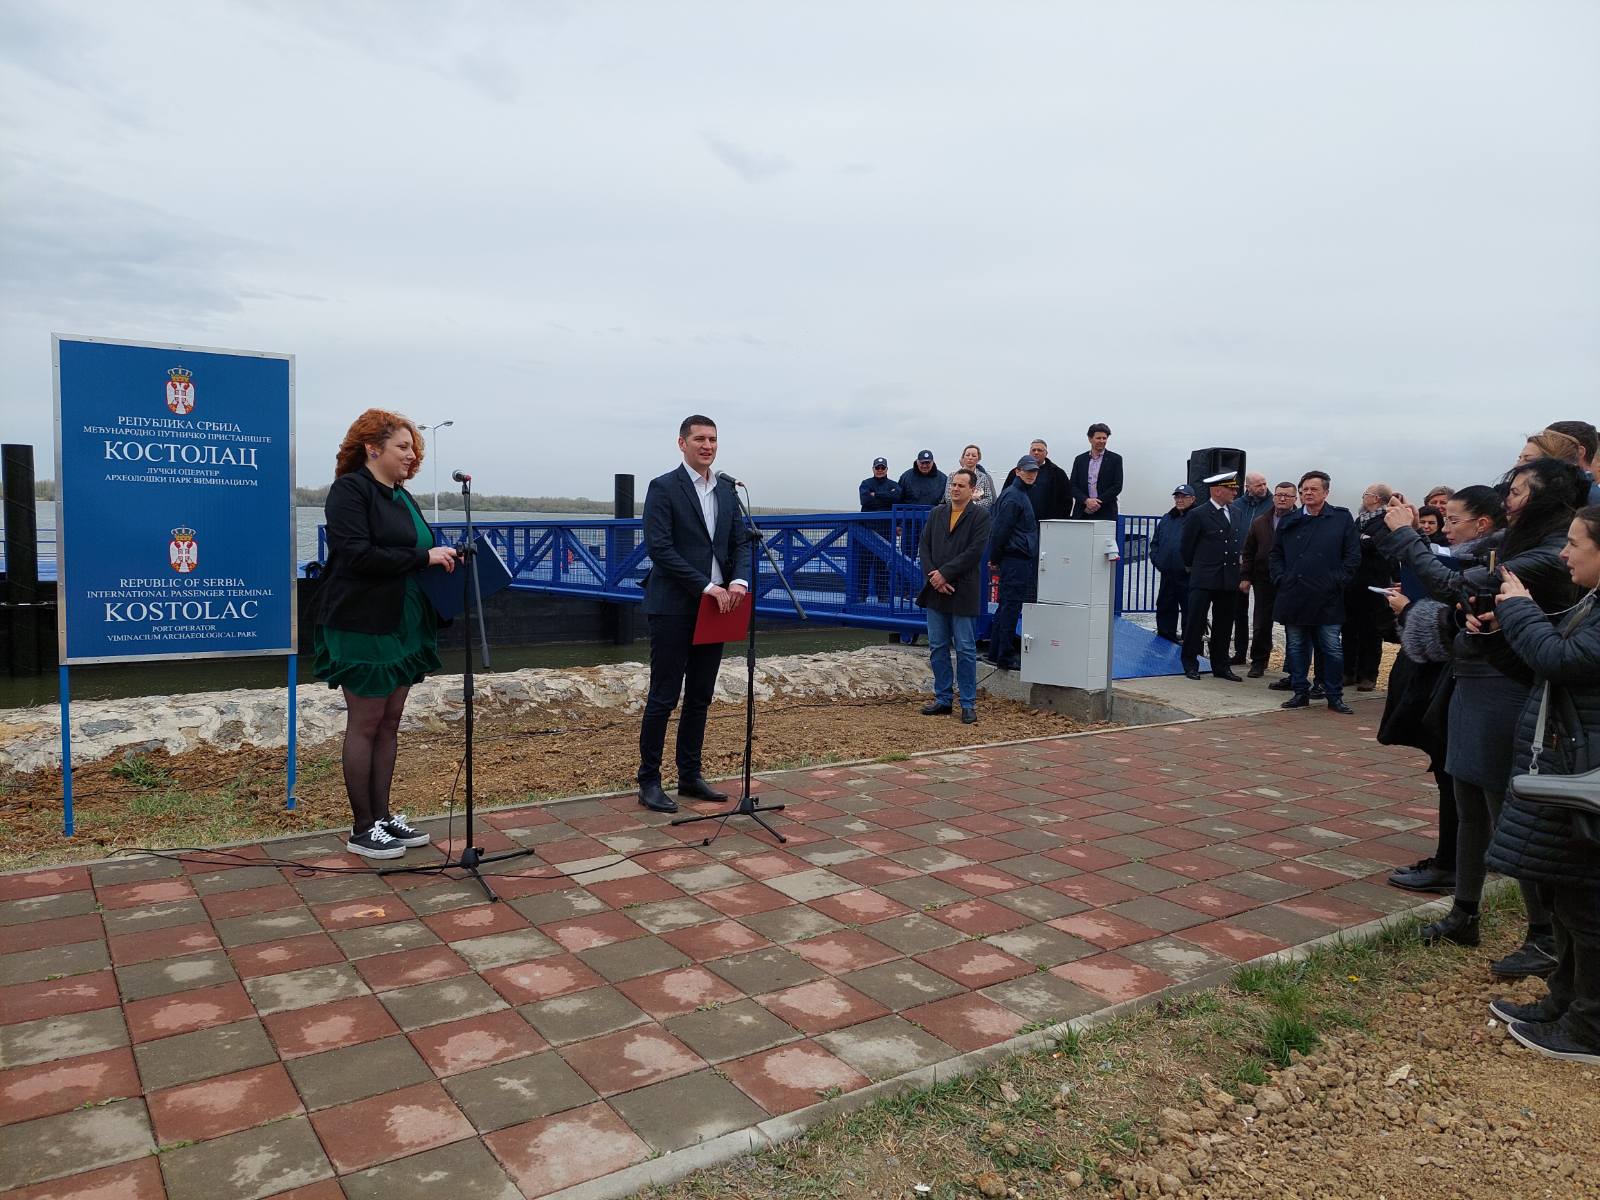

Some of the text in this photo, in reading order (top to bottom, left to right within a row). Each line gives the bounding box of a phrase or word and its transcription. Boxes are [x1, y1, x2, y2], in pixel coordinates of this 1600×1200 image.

[118, 415, 242, 433] РЕПУБЛИКА СРБИЈА
[83, 425, 272, 443] МЕЂУНАРОДНО ПУТНИЧКО ПРИСТАНИШТЕ
[104, 440, 258, 471] КОСТОЛАЦ
[146, 467, 220, 477] ЛУЧКИ ОПЕРАТЕР
[104, 474, 258, 487] АРХЕОЛОШКИ ПАРК ВИМИНАЦИЈУМ
[120, 578, 245, 588] REPUBLIC OF SERBIA
[87, 589, 274, 599] INTERNATIONAL PASSENGER TERMINAL
[104, 600, 258, 622] KOSTOLAC
[174, 624, 216, 632] OPERATOR
[107, 634, 161, 642] VIMINACIUM
[162, 632, 236, 640] ARCHAEOLOGICAL
